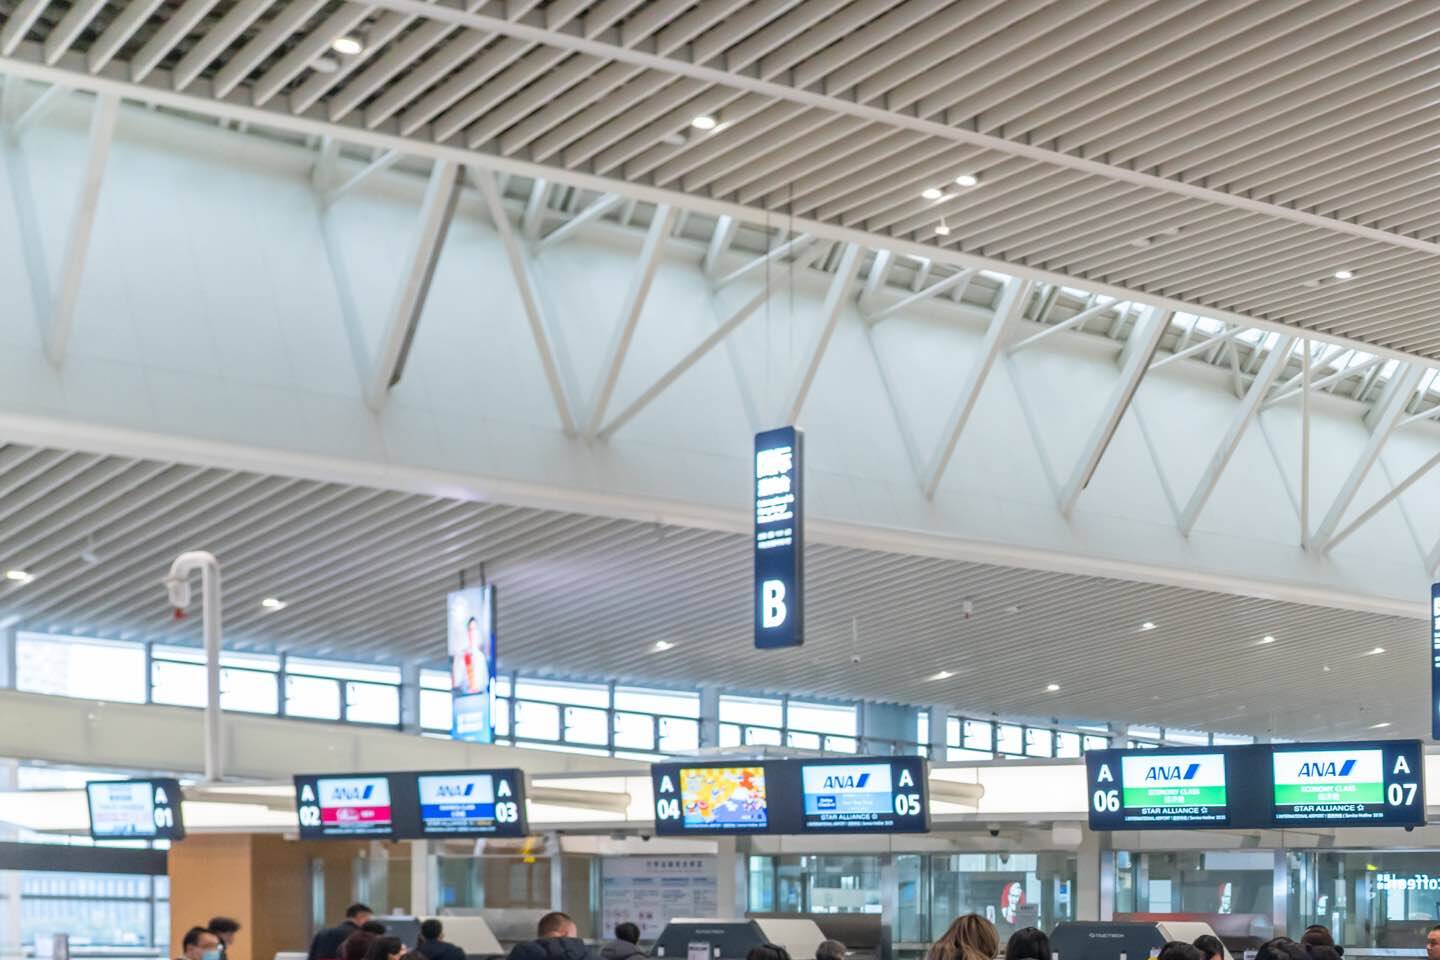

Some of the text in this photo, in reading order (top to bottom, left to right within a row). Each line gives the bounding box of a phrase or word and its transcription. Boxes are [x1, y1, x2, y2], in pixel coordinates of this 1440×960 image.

[762, 580, 787, 628] B
[1097, 764, 1114, 782] A
[1145, 766, 1181, 781] ANA
[1298, 762, 1336, 777] ANA
[1393, 756, 1410, 774] A
[660, 775, 674, 793] A
[823, 776, 854, 789] ANA
[899, 769, 914, 787] A
[155, 787, 168, 804] A
[301, 784, 315, 802] A
[498, 779, 512, 797] A
[1388, 784, 1417, 805] 07
[657, 798, 680, 820] 04
[895, 794, 920, 815] 05
[1094, 790, 1119, 812] 06
[154, 807, 173, 828] 01
[300, 806, 321, 826] 02
[496, 802, 518, 823] 03
